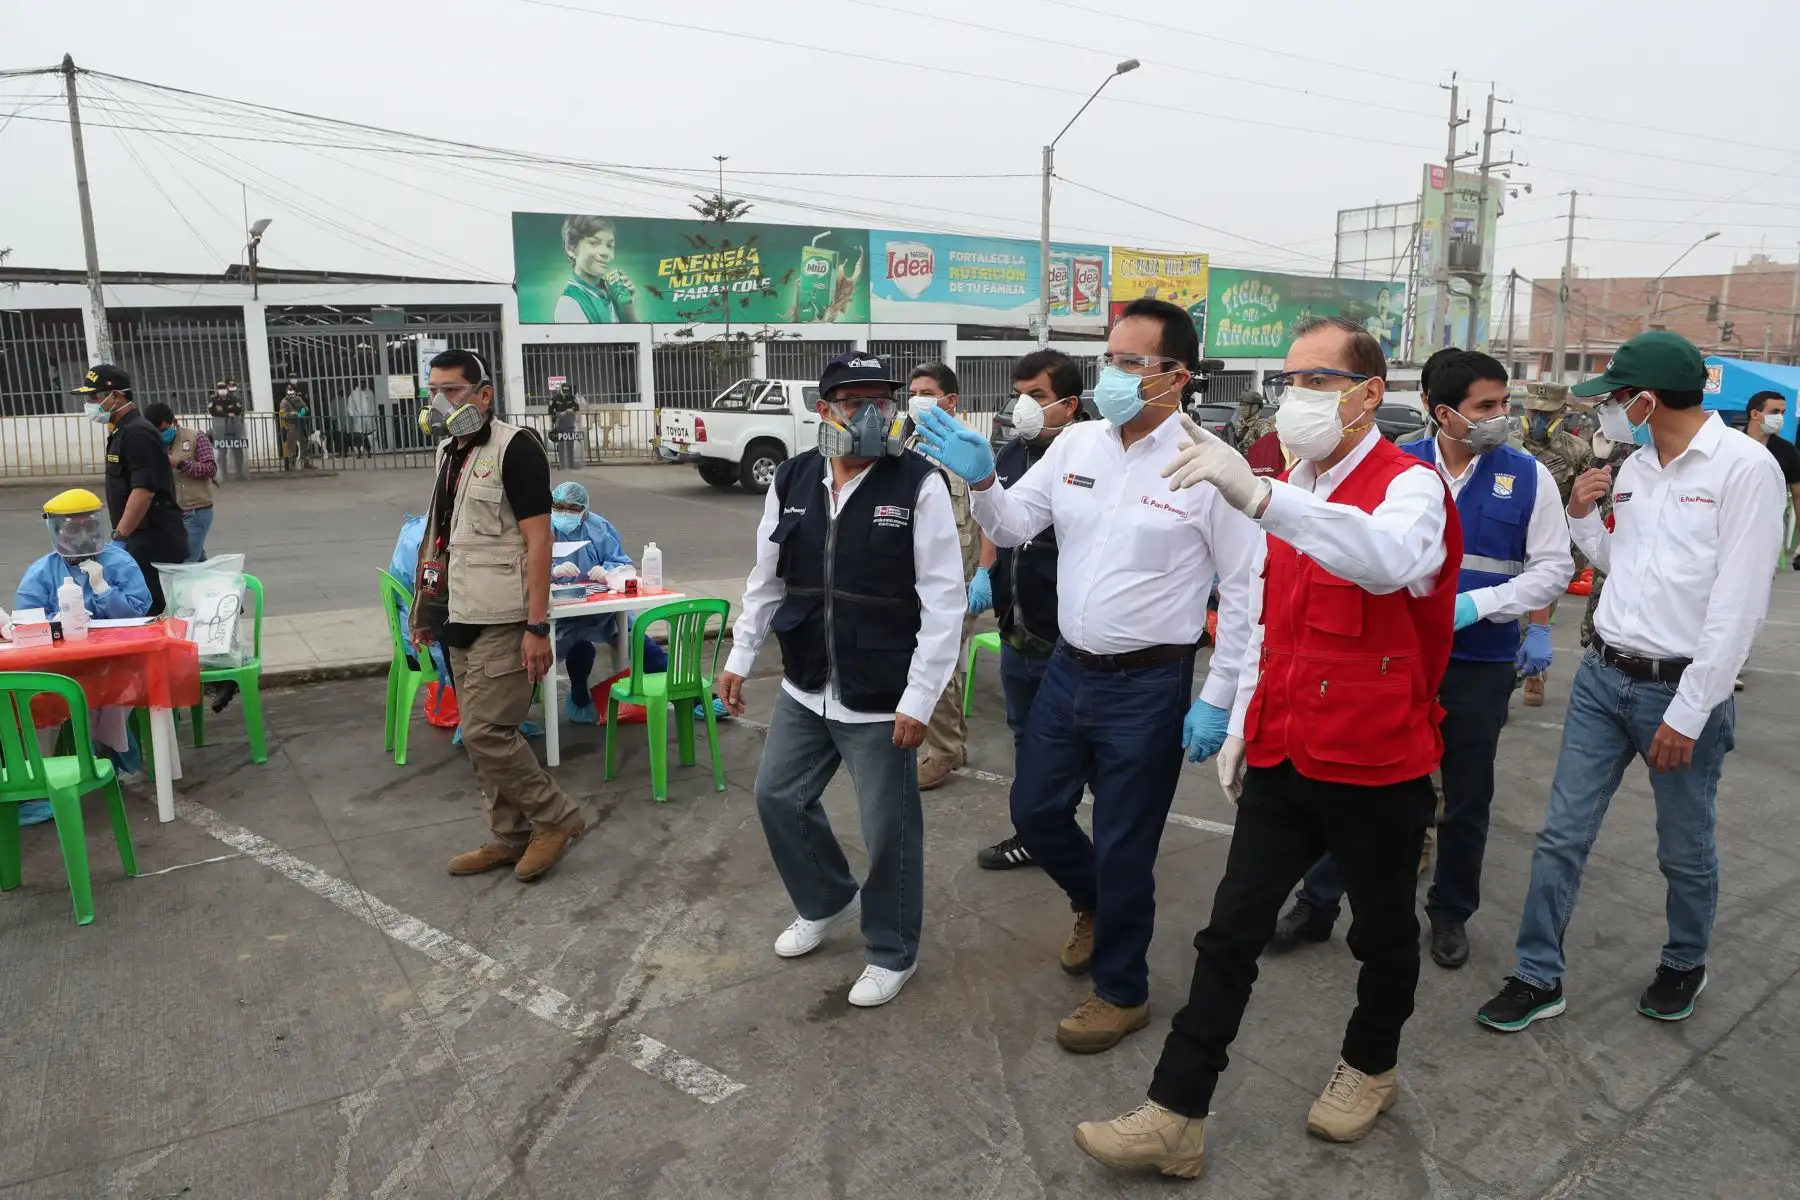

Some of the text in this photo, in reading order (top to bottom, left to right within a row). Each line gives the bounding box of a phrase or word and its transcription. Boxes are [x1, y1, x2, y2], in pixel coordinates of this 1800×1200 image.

[949, 251, 1026, 264] FORTALECE LA
[806, 263, 827, 273] MILO
[886, 251, 933, 279] Ideal
[668, 266, 760, 289] NUTRIA
[949, 265, 1026, 281] NUTRICIÓN
[1049, 267, 1069, 282] deal
[672, 284, 720, 302] PARA
[732, 277, 771, 293] COLE
[950, 282, 1026, 295] DE TU FAMILIA
[557, 432, 585, 441] POLICIA
[666, 426, 689, 438] TOYOTA
[214, 439, 249, 449] POLICIA
